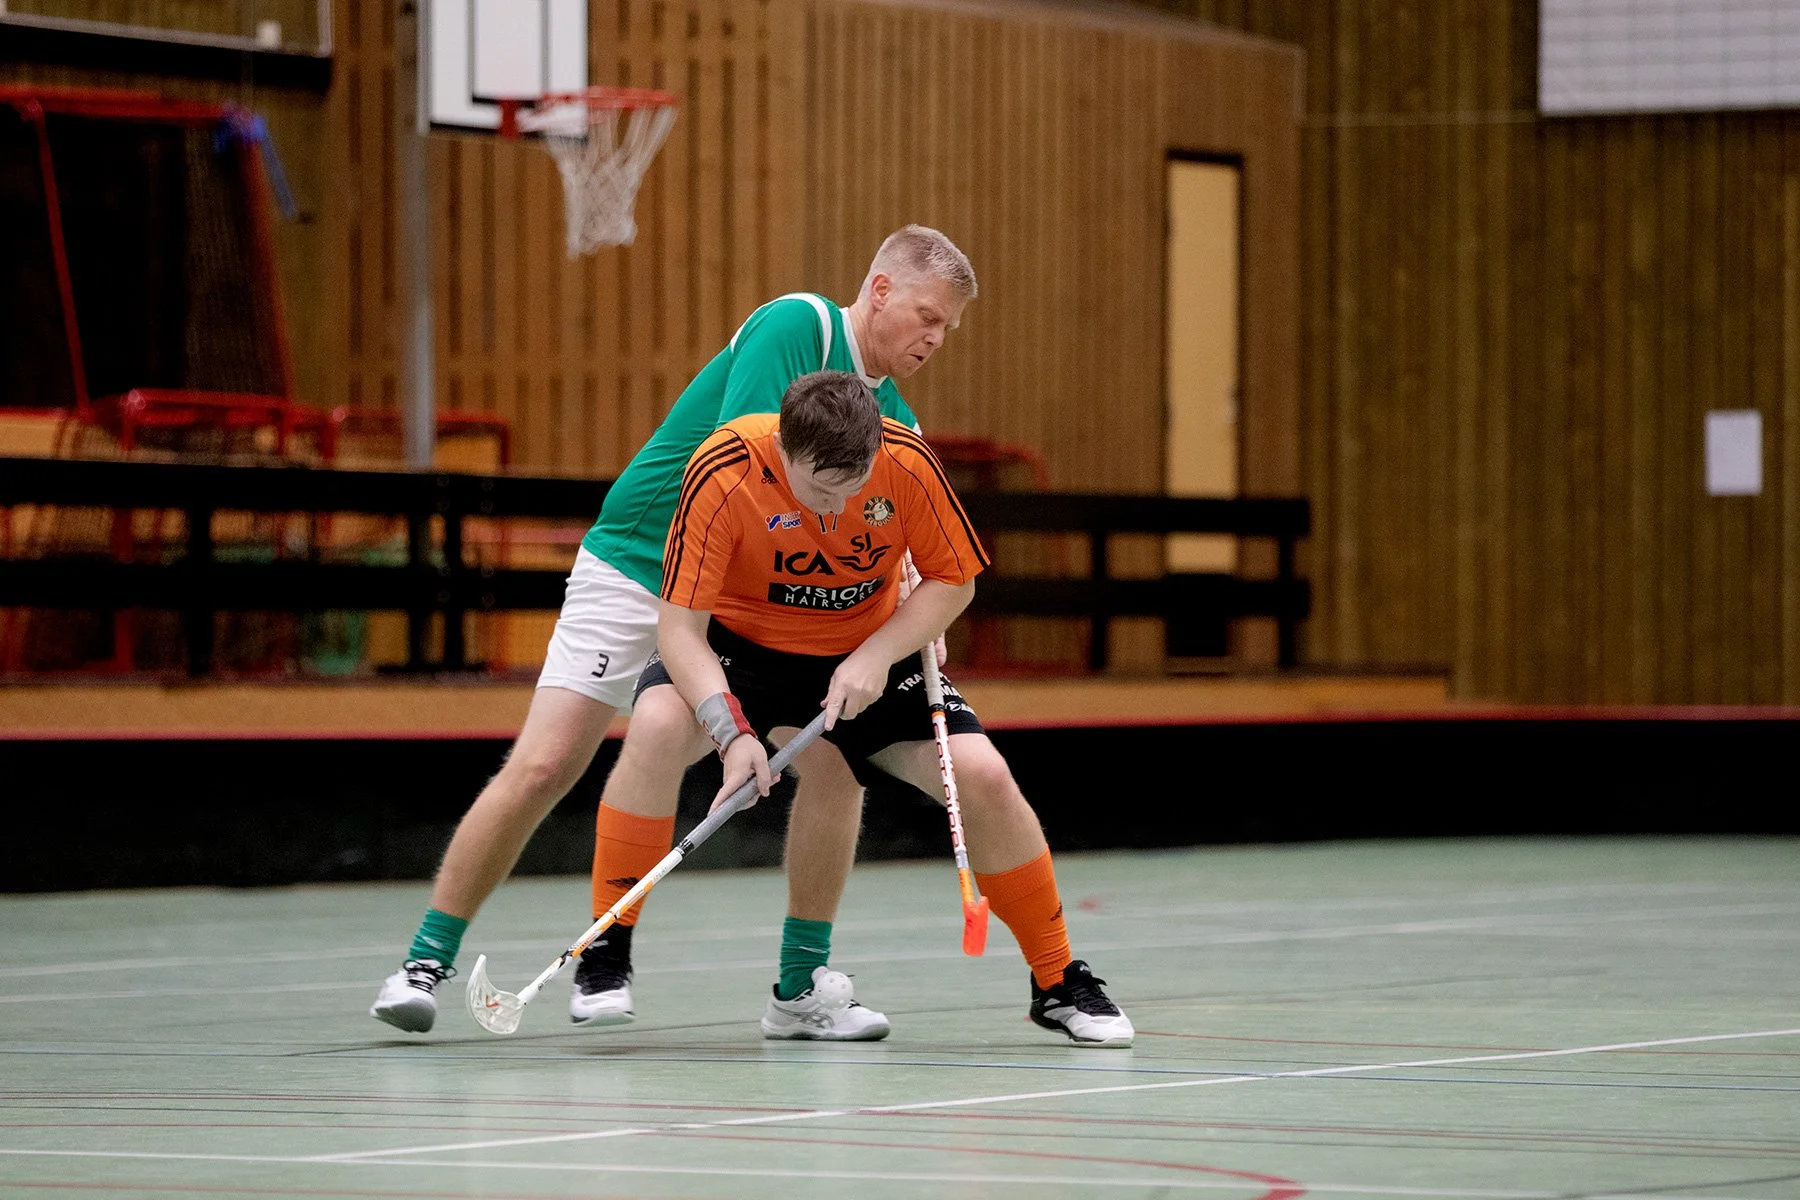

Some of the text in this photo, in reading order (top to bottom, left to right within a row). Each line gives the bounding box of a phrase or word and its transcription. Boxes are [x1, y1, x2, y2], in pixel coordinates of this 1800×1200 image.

[773, 549, 836, 577] ICA
[784, 584, 874, 610] HAIRCARE
[590, 653, 610, 679] 3
